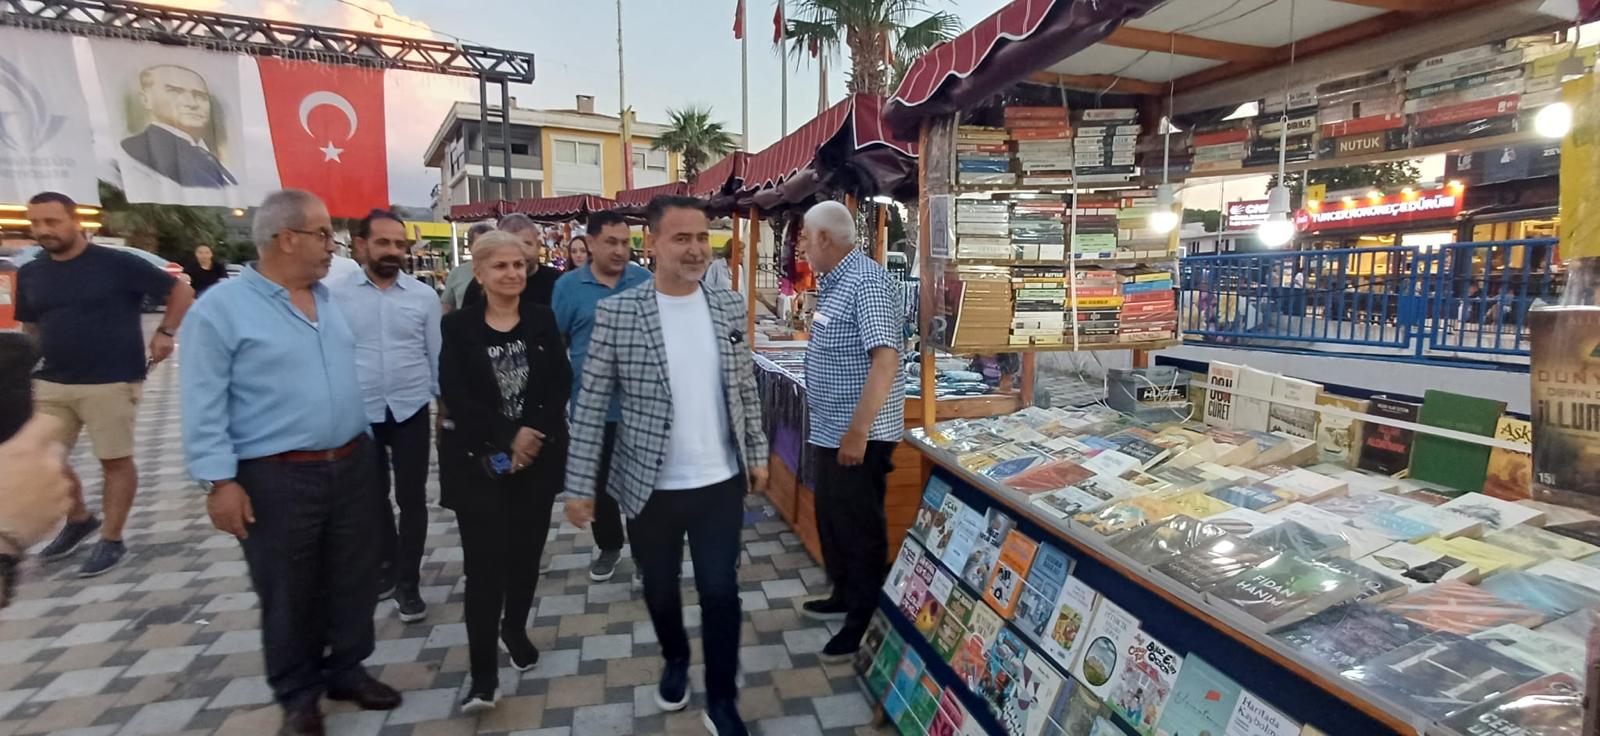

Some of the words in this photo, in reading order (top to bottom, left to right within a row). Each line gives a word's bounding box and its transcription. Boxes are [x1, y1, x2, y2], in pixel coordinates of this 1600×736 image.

[1340, 137, 1380, 152] NUTUK
[1236, 580, 1284, 607] HANIM
[1237, 703, 1284, 736] Kaybolm
[1242, 695, 1280, 730] Haritada
